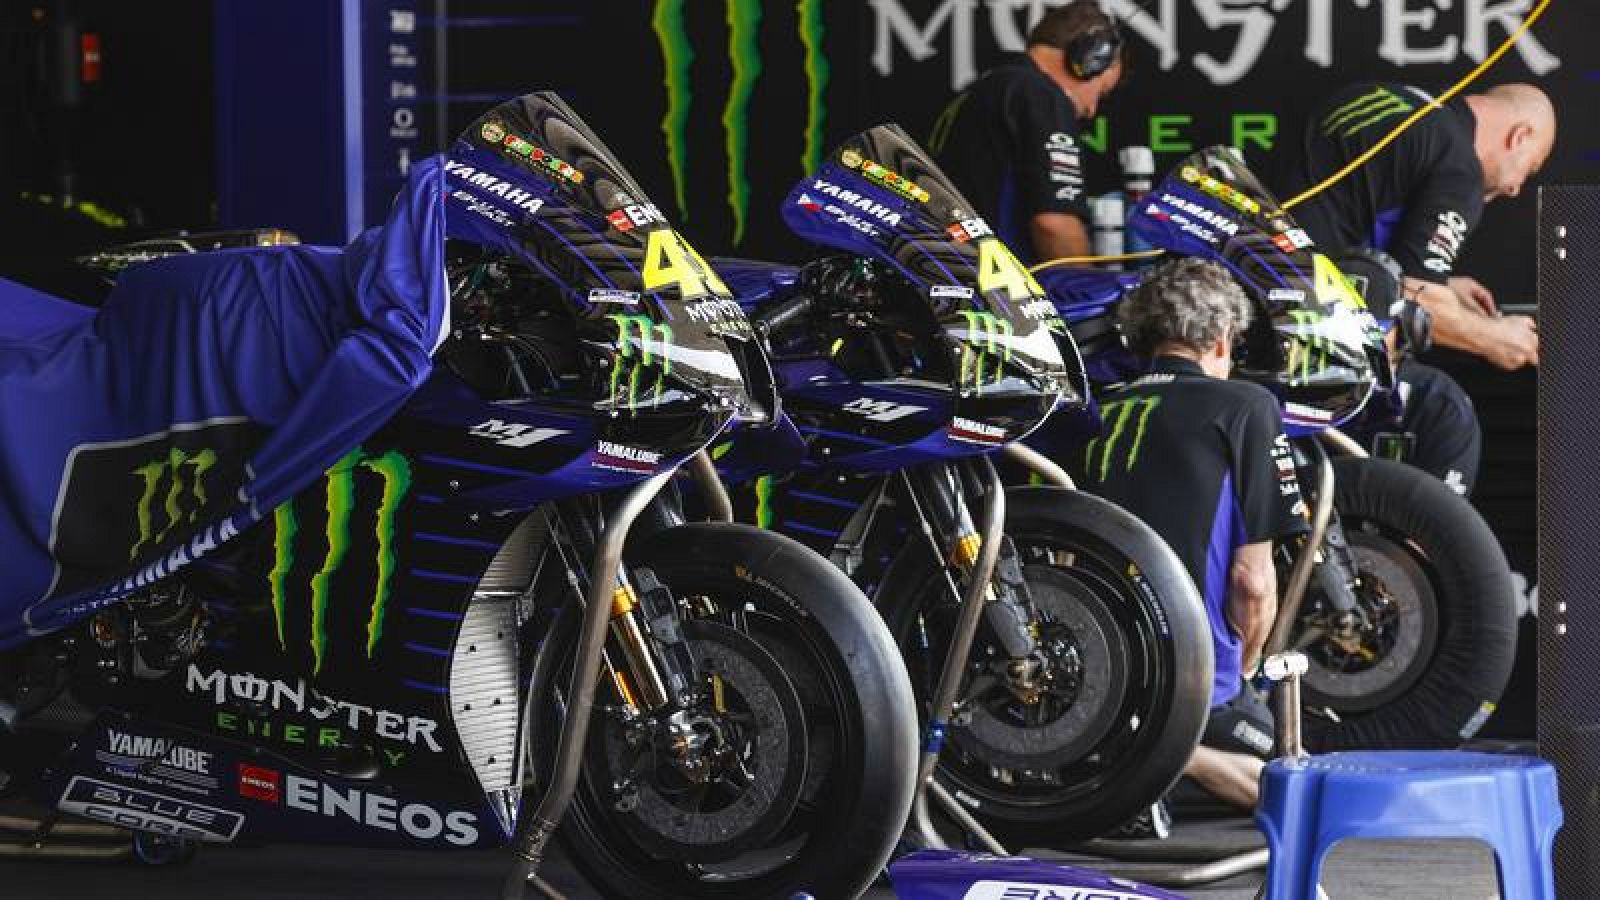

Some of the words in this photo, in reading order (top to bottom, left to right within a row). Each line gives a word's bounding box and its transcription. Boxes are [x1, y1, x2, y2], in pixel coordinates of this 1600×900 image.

[446, 160, 545, 215] YAMAHA
[813, 179, 902, 227] YAMAHA
[977, 238, 1046, 301] 4
[216, 711, 405, 767] ENERY
[285, 775, 479, 845] ENEOS
